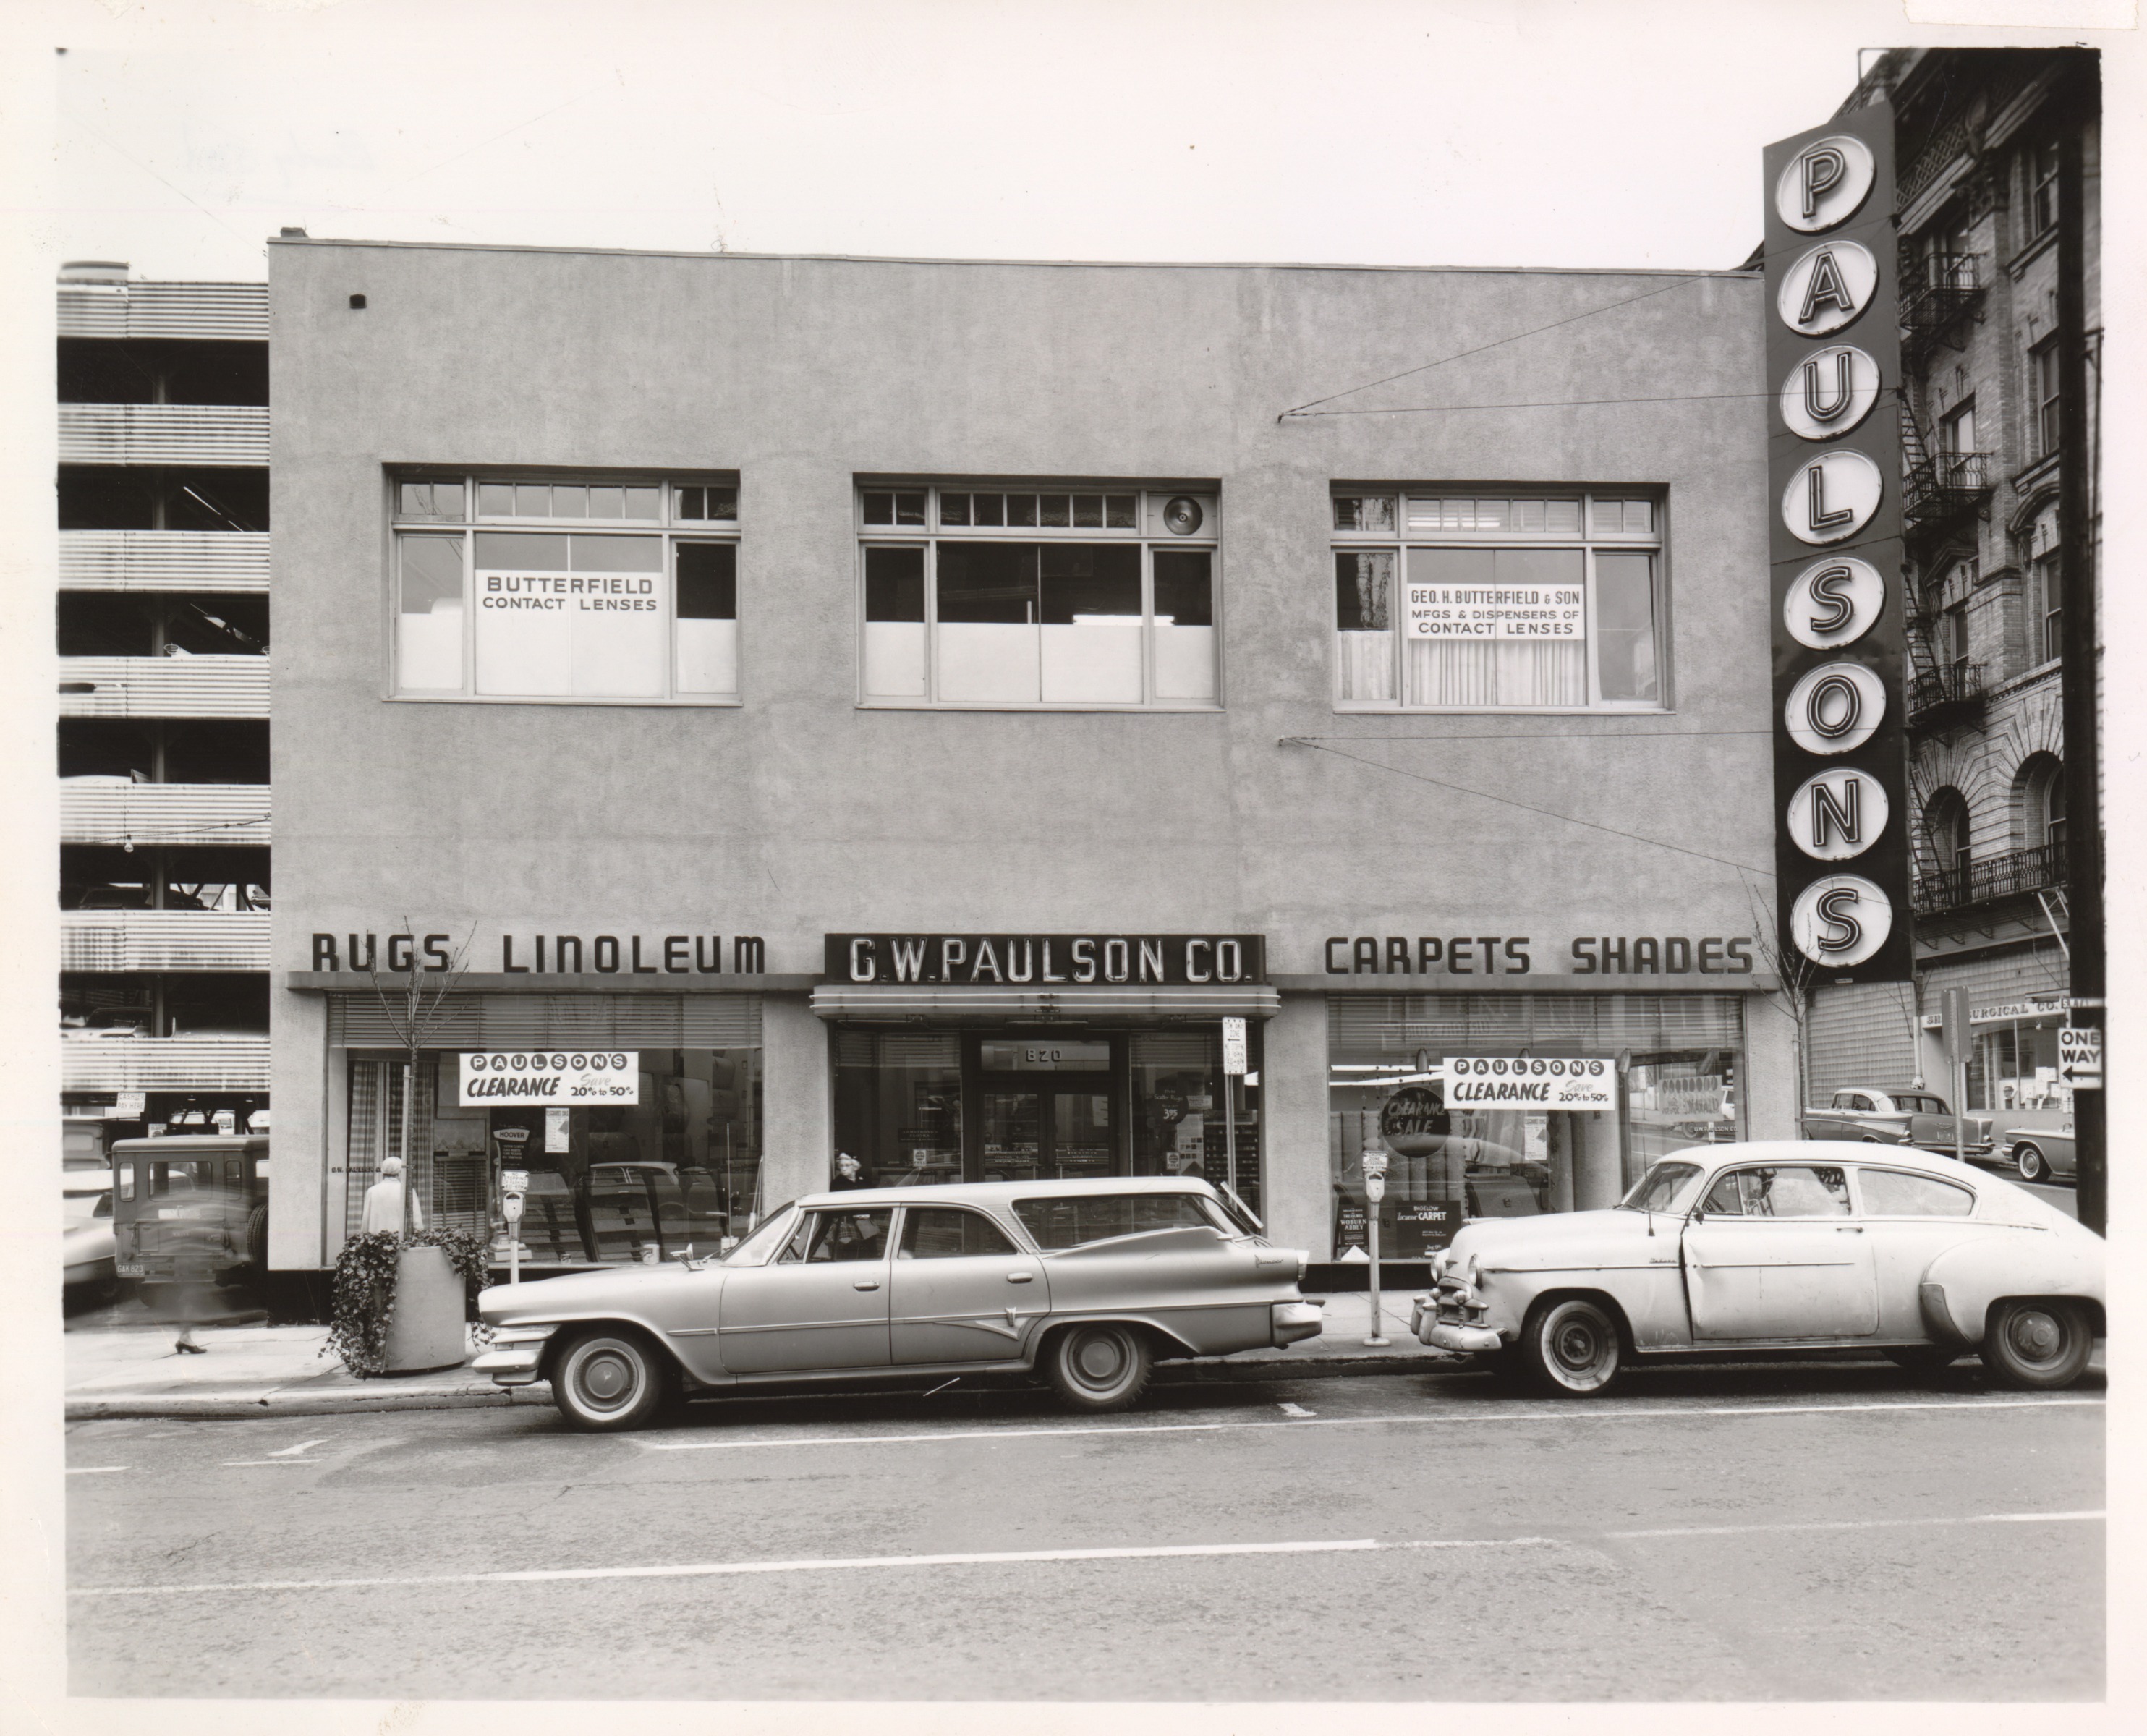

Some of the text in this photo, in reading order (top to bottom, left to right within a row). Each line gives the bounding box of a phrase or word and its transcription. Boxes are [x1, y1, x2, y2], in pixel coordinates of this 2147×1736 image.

[1798, 147, 1861, 952] PAULSONS
[488, 576, 652, 594] BUTTERFIELD
[483, 597, 657, 611] CONTACT LENSES
[1411, 590, 1580, 605] GEO. H. BUTTERFIELD & SON
[1412, 610, 1579, 619] MFGS & DISPENSERS OF
[1418, 623, 1573, 634] CONTACT LENSES
[312, 933, 765, 974] RUGS LINOLEUM
[942, 938, 1164, 983] PAULSON
[1186, 939, 1253, 983] CO.
[1325, 937, 1753, 975] CARPETS SHADES
[2061, 1031, 2101, 1045] ONE
[471, 1054, 627, 1071] PAULSON'S
[1025, 1048, 1062, 1063] 820
[2061, 1049, 2101, 1063] WAY
[1455, 1058, 1604, 1076] PAULSON'S
[467, 1076, 561, 1097] CLEARANCE
[579, 1073, 612, 1086] Save
[1564, 1079, 1594, 1092] Save
[570, 1086, 634, 1097] 20% to 50%
[1453, 1082, 1551, 1102] CLEARANCE
[1559, 1092, 1609, 1102] 20% to 50%
[1418, 1212, 1447, 1221] CARPET
[130, 1264, 143, 1273] 823
